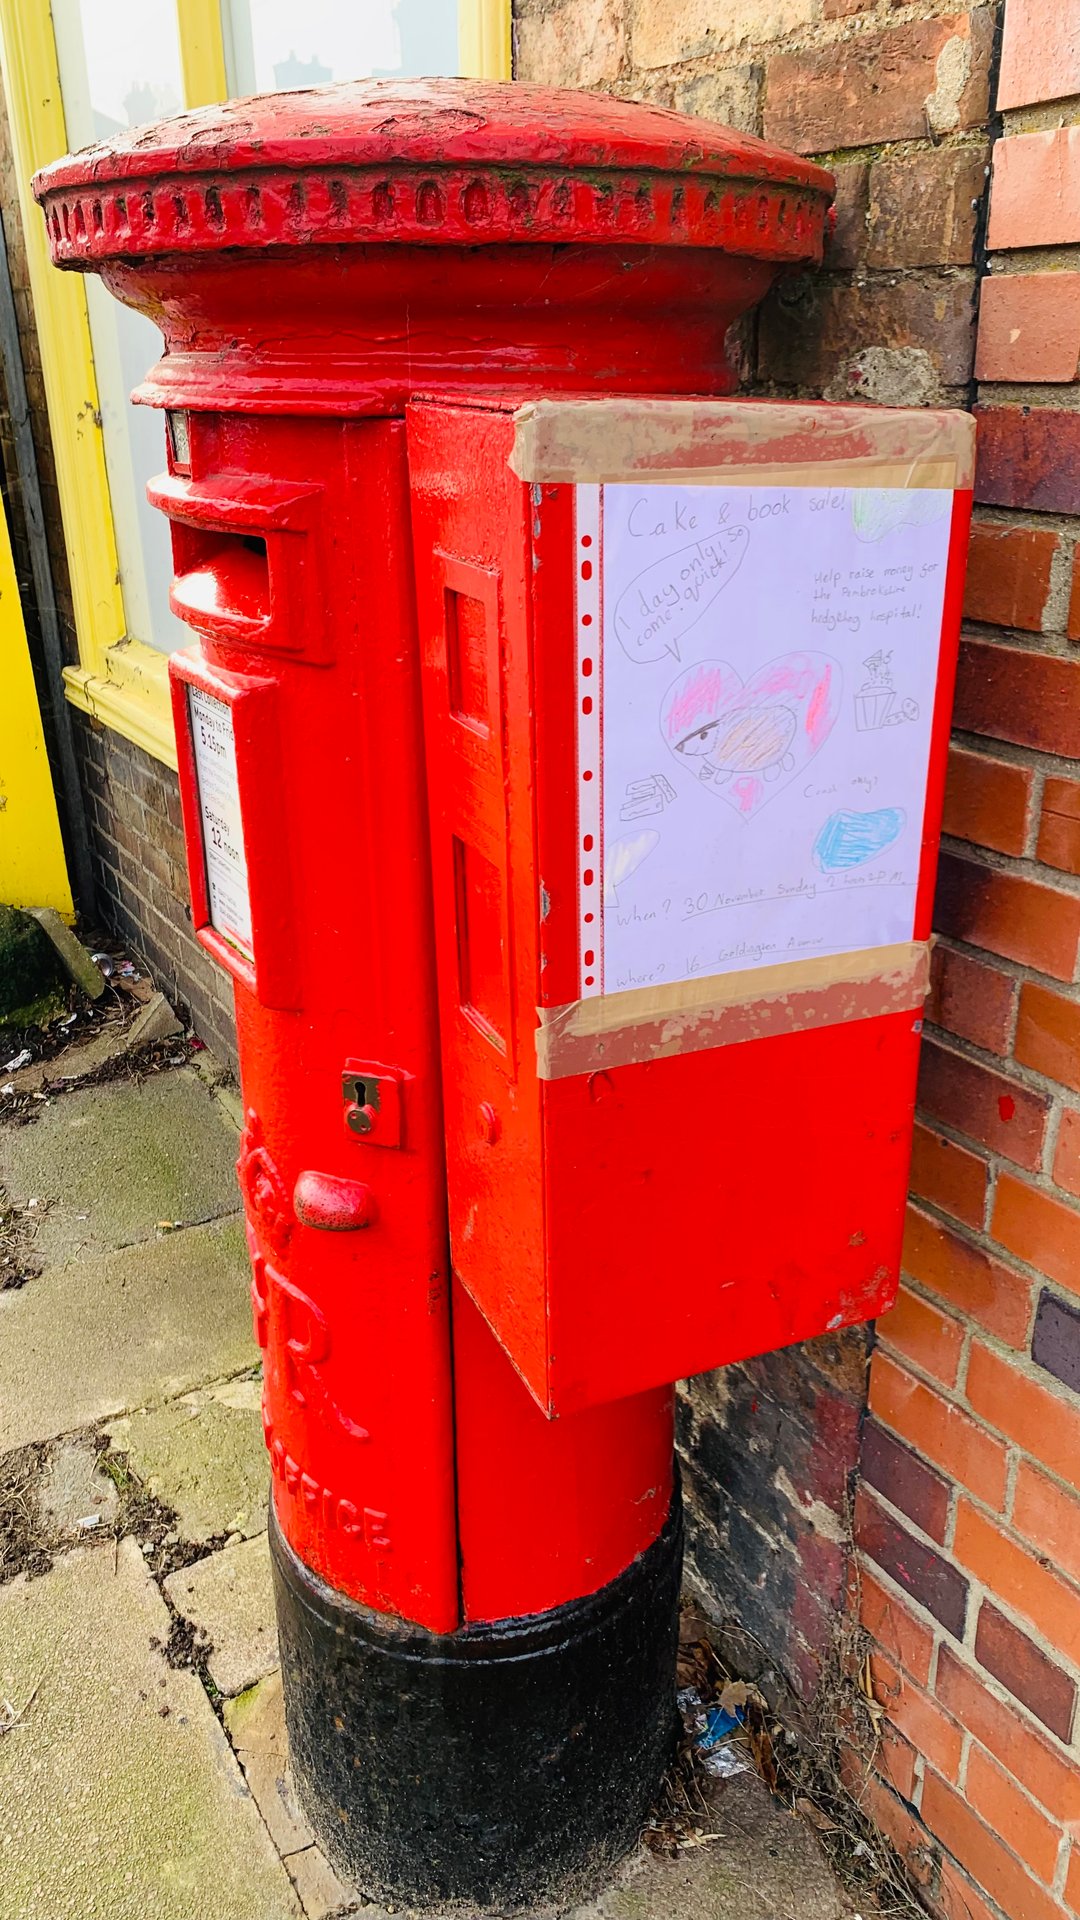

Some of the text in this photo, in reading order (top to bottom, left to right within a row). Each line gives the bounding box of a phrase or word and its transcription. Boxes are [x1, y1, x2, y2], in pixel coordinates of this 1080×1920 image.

[627, 496, 698, 538] Cake
[717, 501, 731, 526] &
[747, 493, 792, 522] book
[814, 567, 842, 589] Help
[638, 584, 681, 617] day
[204, 805, 230, 837] Saturday
[211, 826, 223, 850] 12
[684, 892, 709, 914] 30
